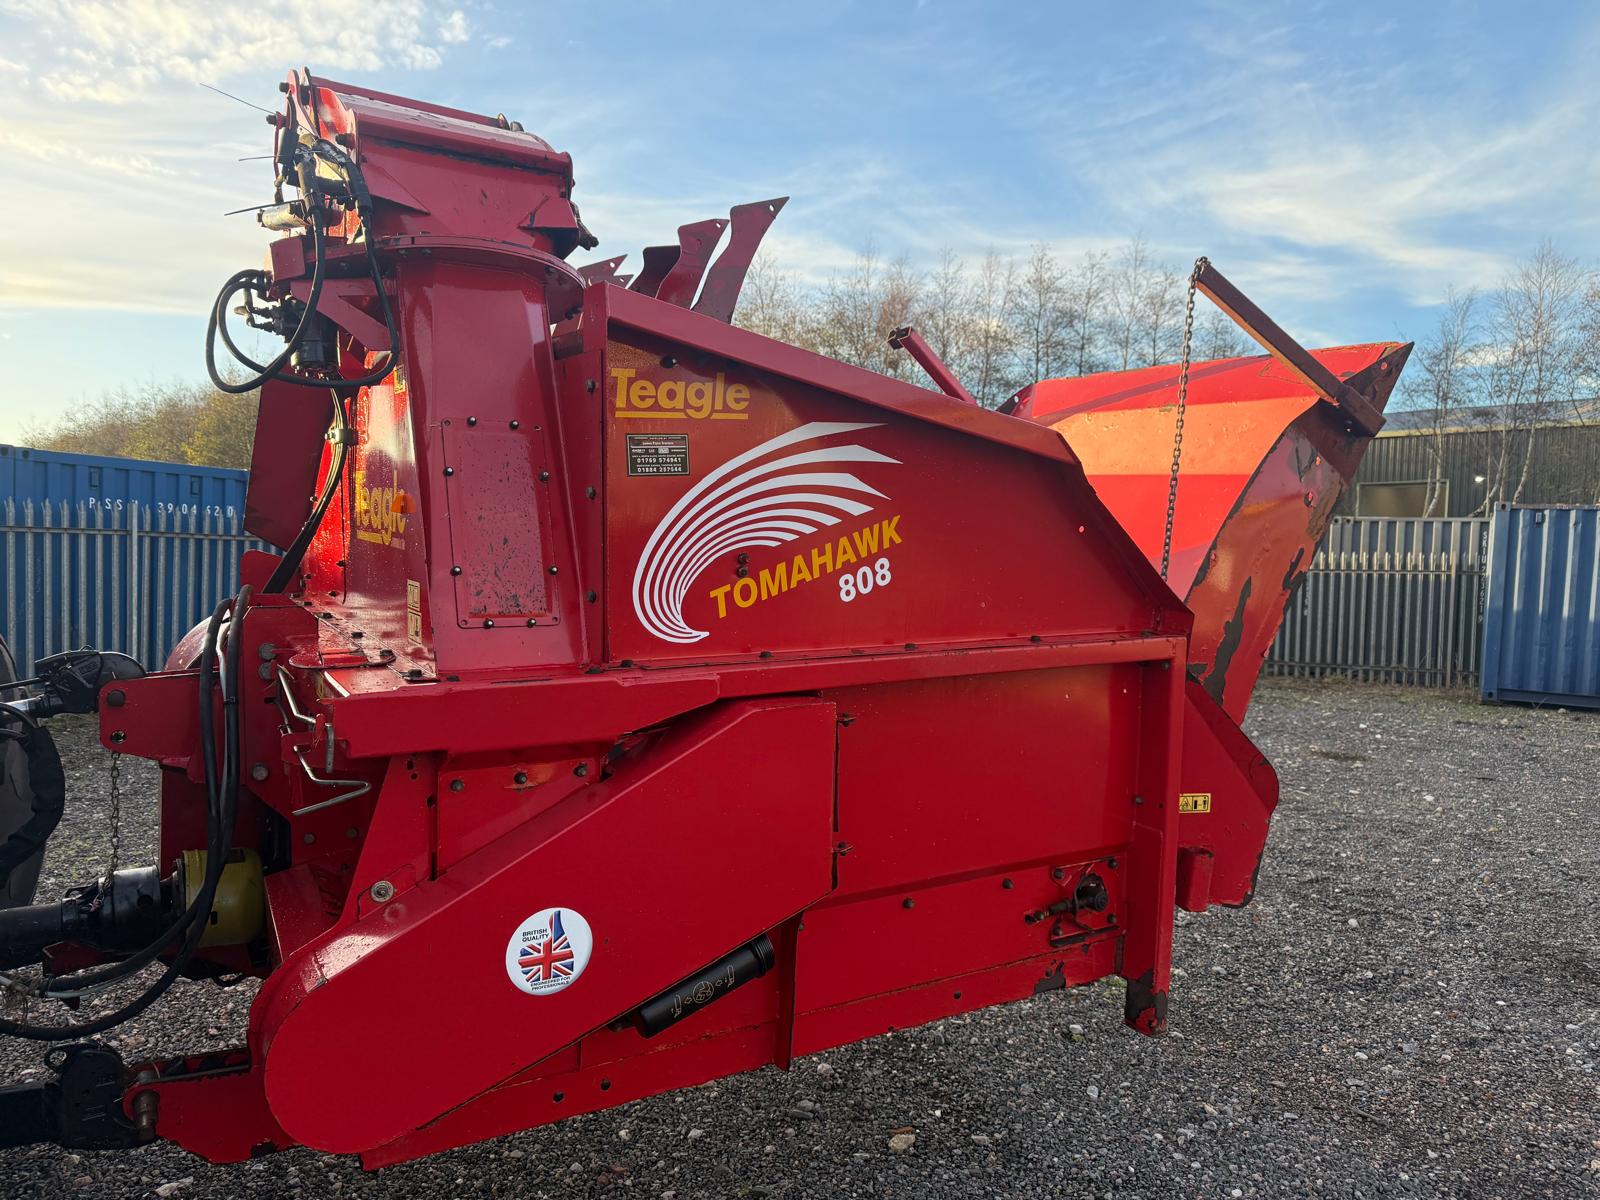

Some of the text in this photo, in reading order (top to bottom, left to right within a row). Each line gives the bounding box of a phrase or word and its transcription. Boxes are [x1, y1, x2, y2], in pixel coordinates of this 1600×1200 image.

[610, 367, 750, 420] Teagle
[709, 515, 904, 619] TOMAHAWK
[838, 557, 892, 603] 808
[522, 928, 548, 937] BRITISH
[522, 932, 550, 942] QUALITY
[530, 978, 561, 987] ENGINEERED
[531, 980, 570, 991] PROFESSIONALS
